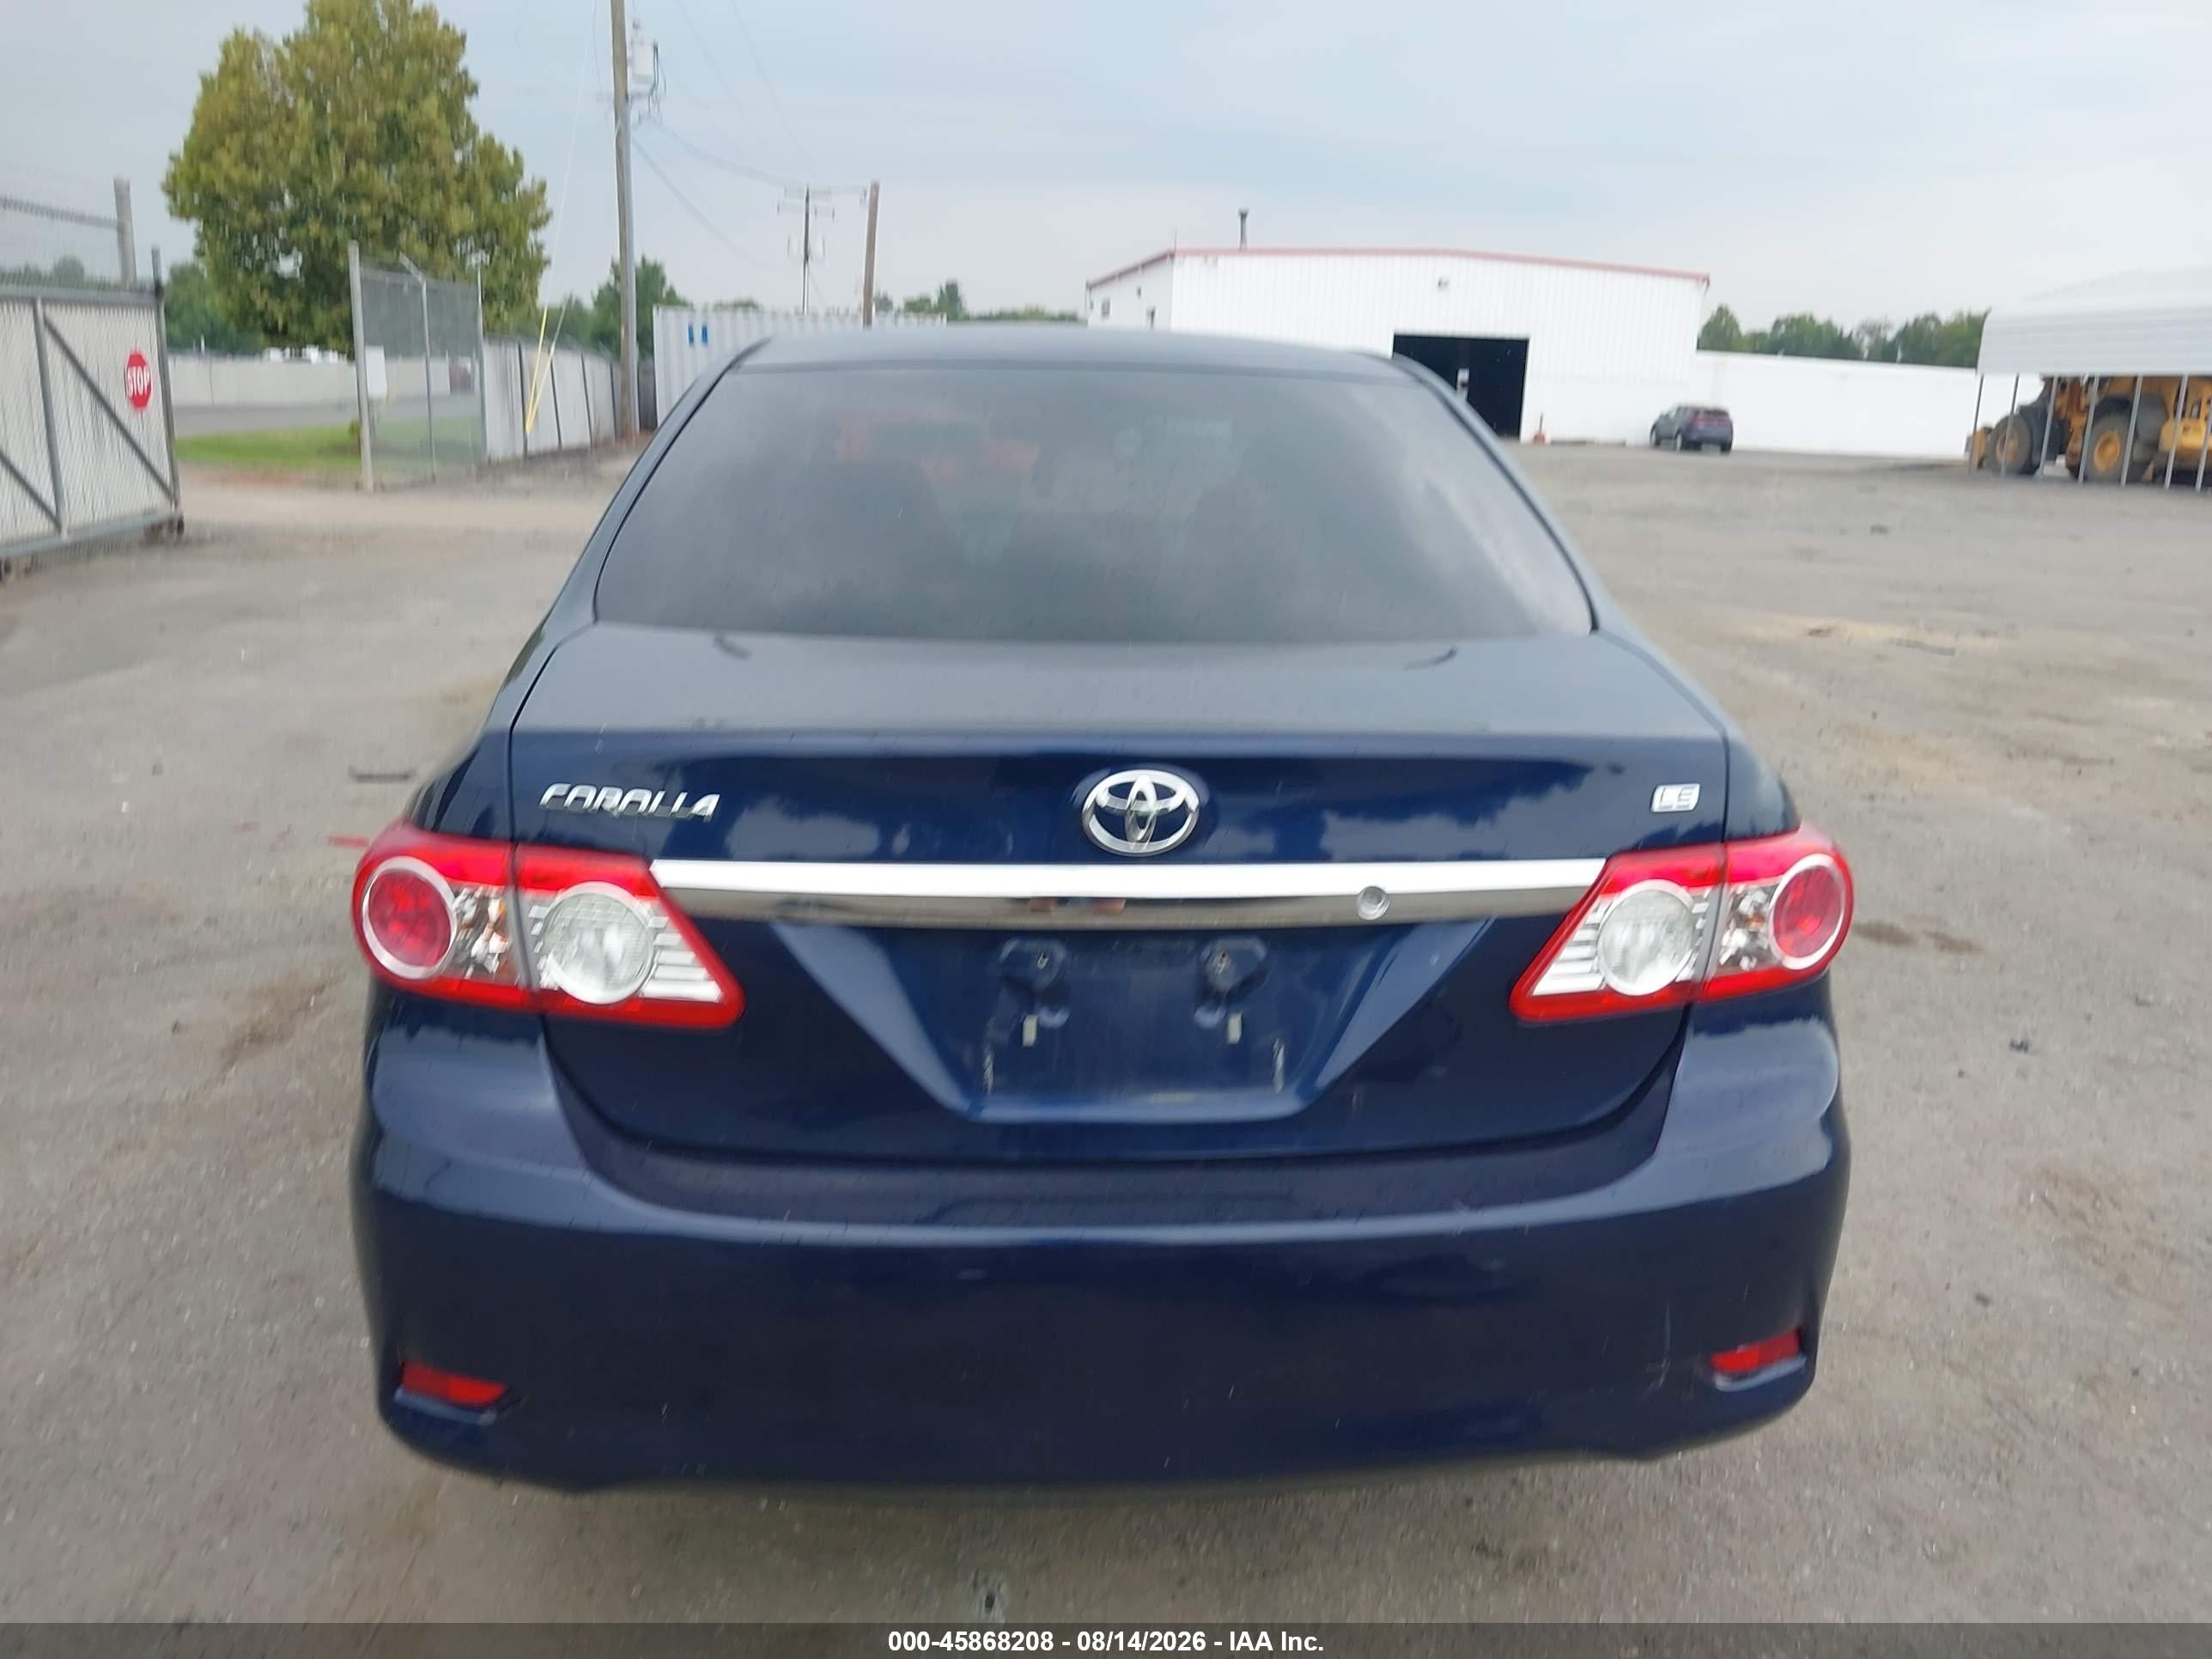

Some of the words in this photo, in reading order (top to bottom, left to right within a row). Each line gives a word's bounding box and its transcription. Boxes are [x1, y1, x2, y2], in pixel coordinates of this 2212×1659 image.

[127, 366, 150, 398] STOP
[538, 782, 721, 823] COROLLA
[1651, 782, 1700, 813] LE
